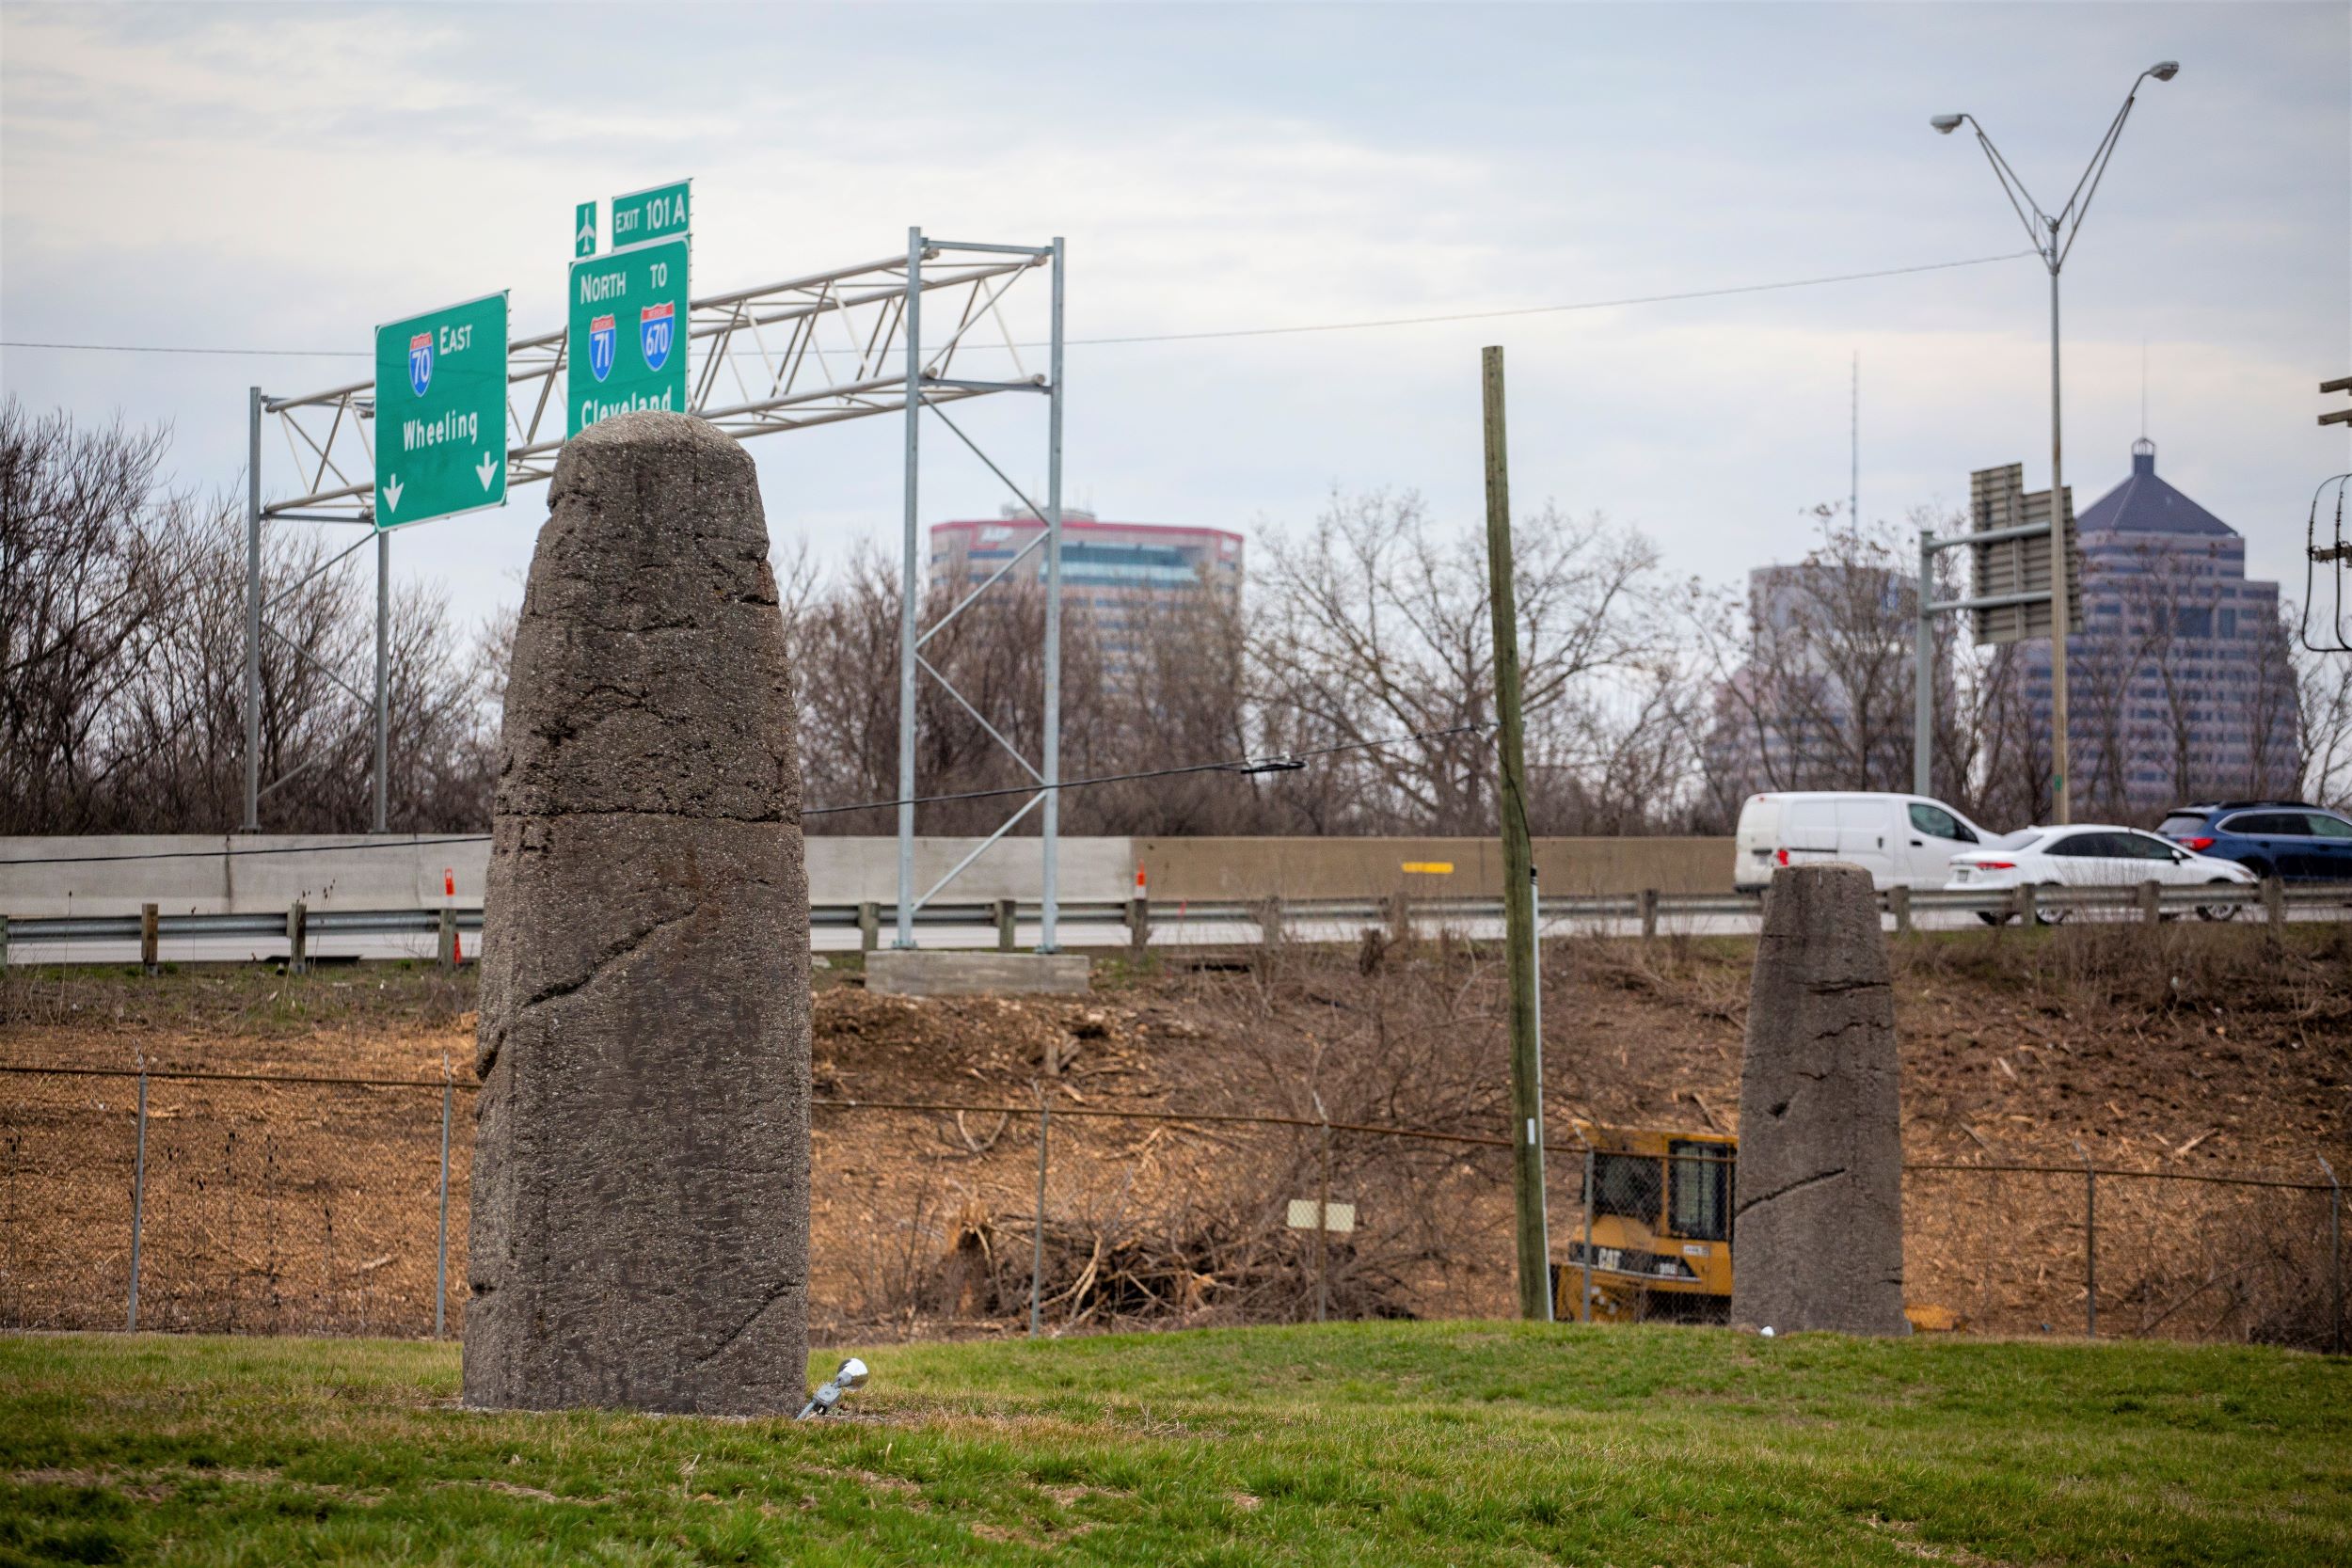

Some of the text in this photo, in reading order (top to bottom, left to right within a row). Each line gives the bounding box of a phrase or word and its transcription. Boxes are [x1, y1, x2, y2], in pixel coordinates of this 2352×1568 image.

[615, 208, 640, 234] EXIT
[580, 262, 667, 304] NORTH TO
[439, 325, 472, 356] EAST
[594, 331, 610, 369] 71
[646, 322, 668, 356] 670
[412, 348, 430, 385] 70
[403, 408, 478, 451] Wheeling
[1598, 1247, 1623, 1270] CAT
